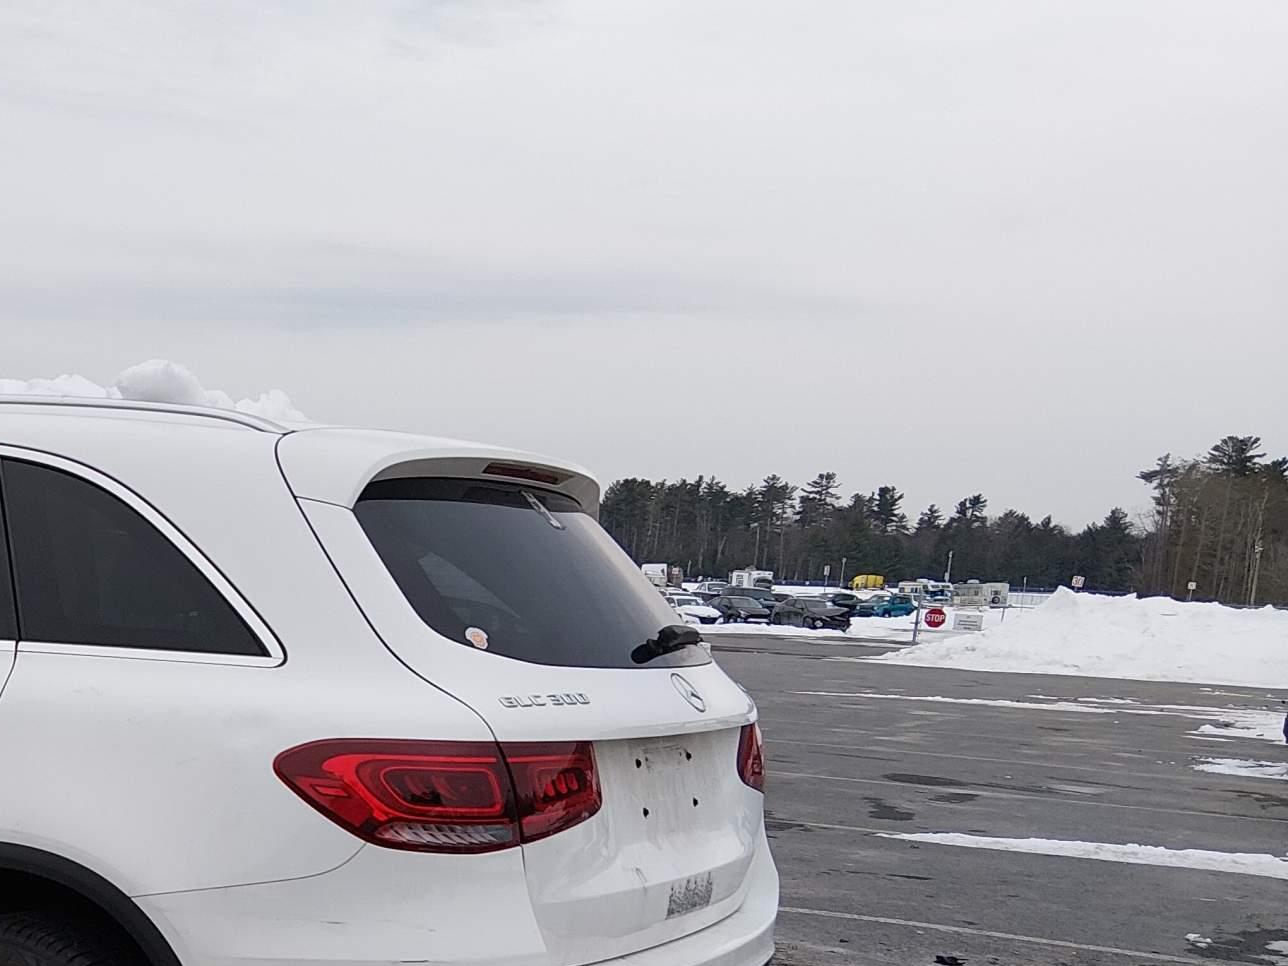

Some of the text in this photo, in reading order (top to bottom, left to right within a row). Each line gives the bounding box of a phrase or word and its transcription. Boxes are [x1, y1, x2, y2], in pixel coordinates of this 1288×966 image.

[926, 613, 945, 622] STOP
[497, 693, 591, 709] GLC 300
